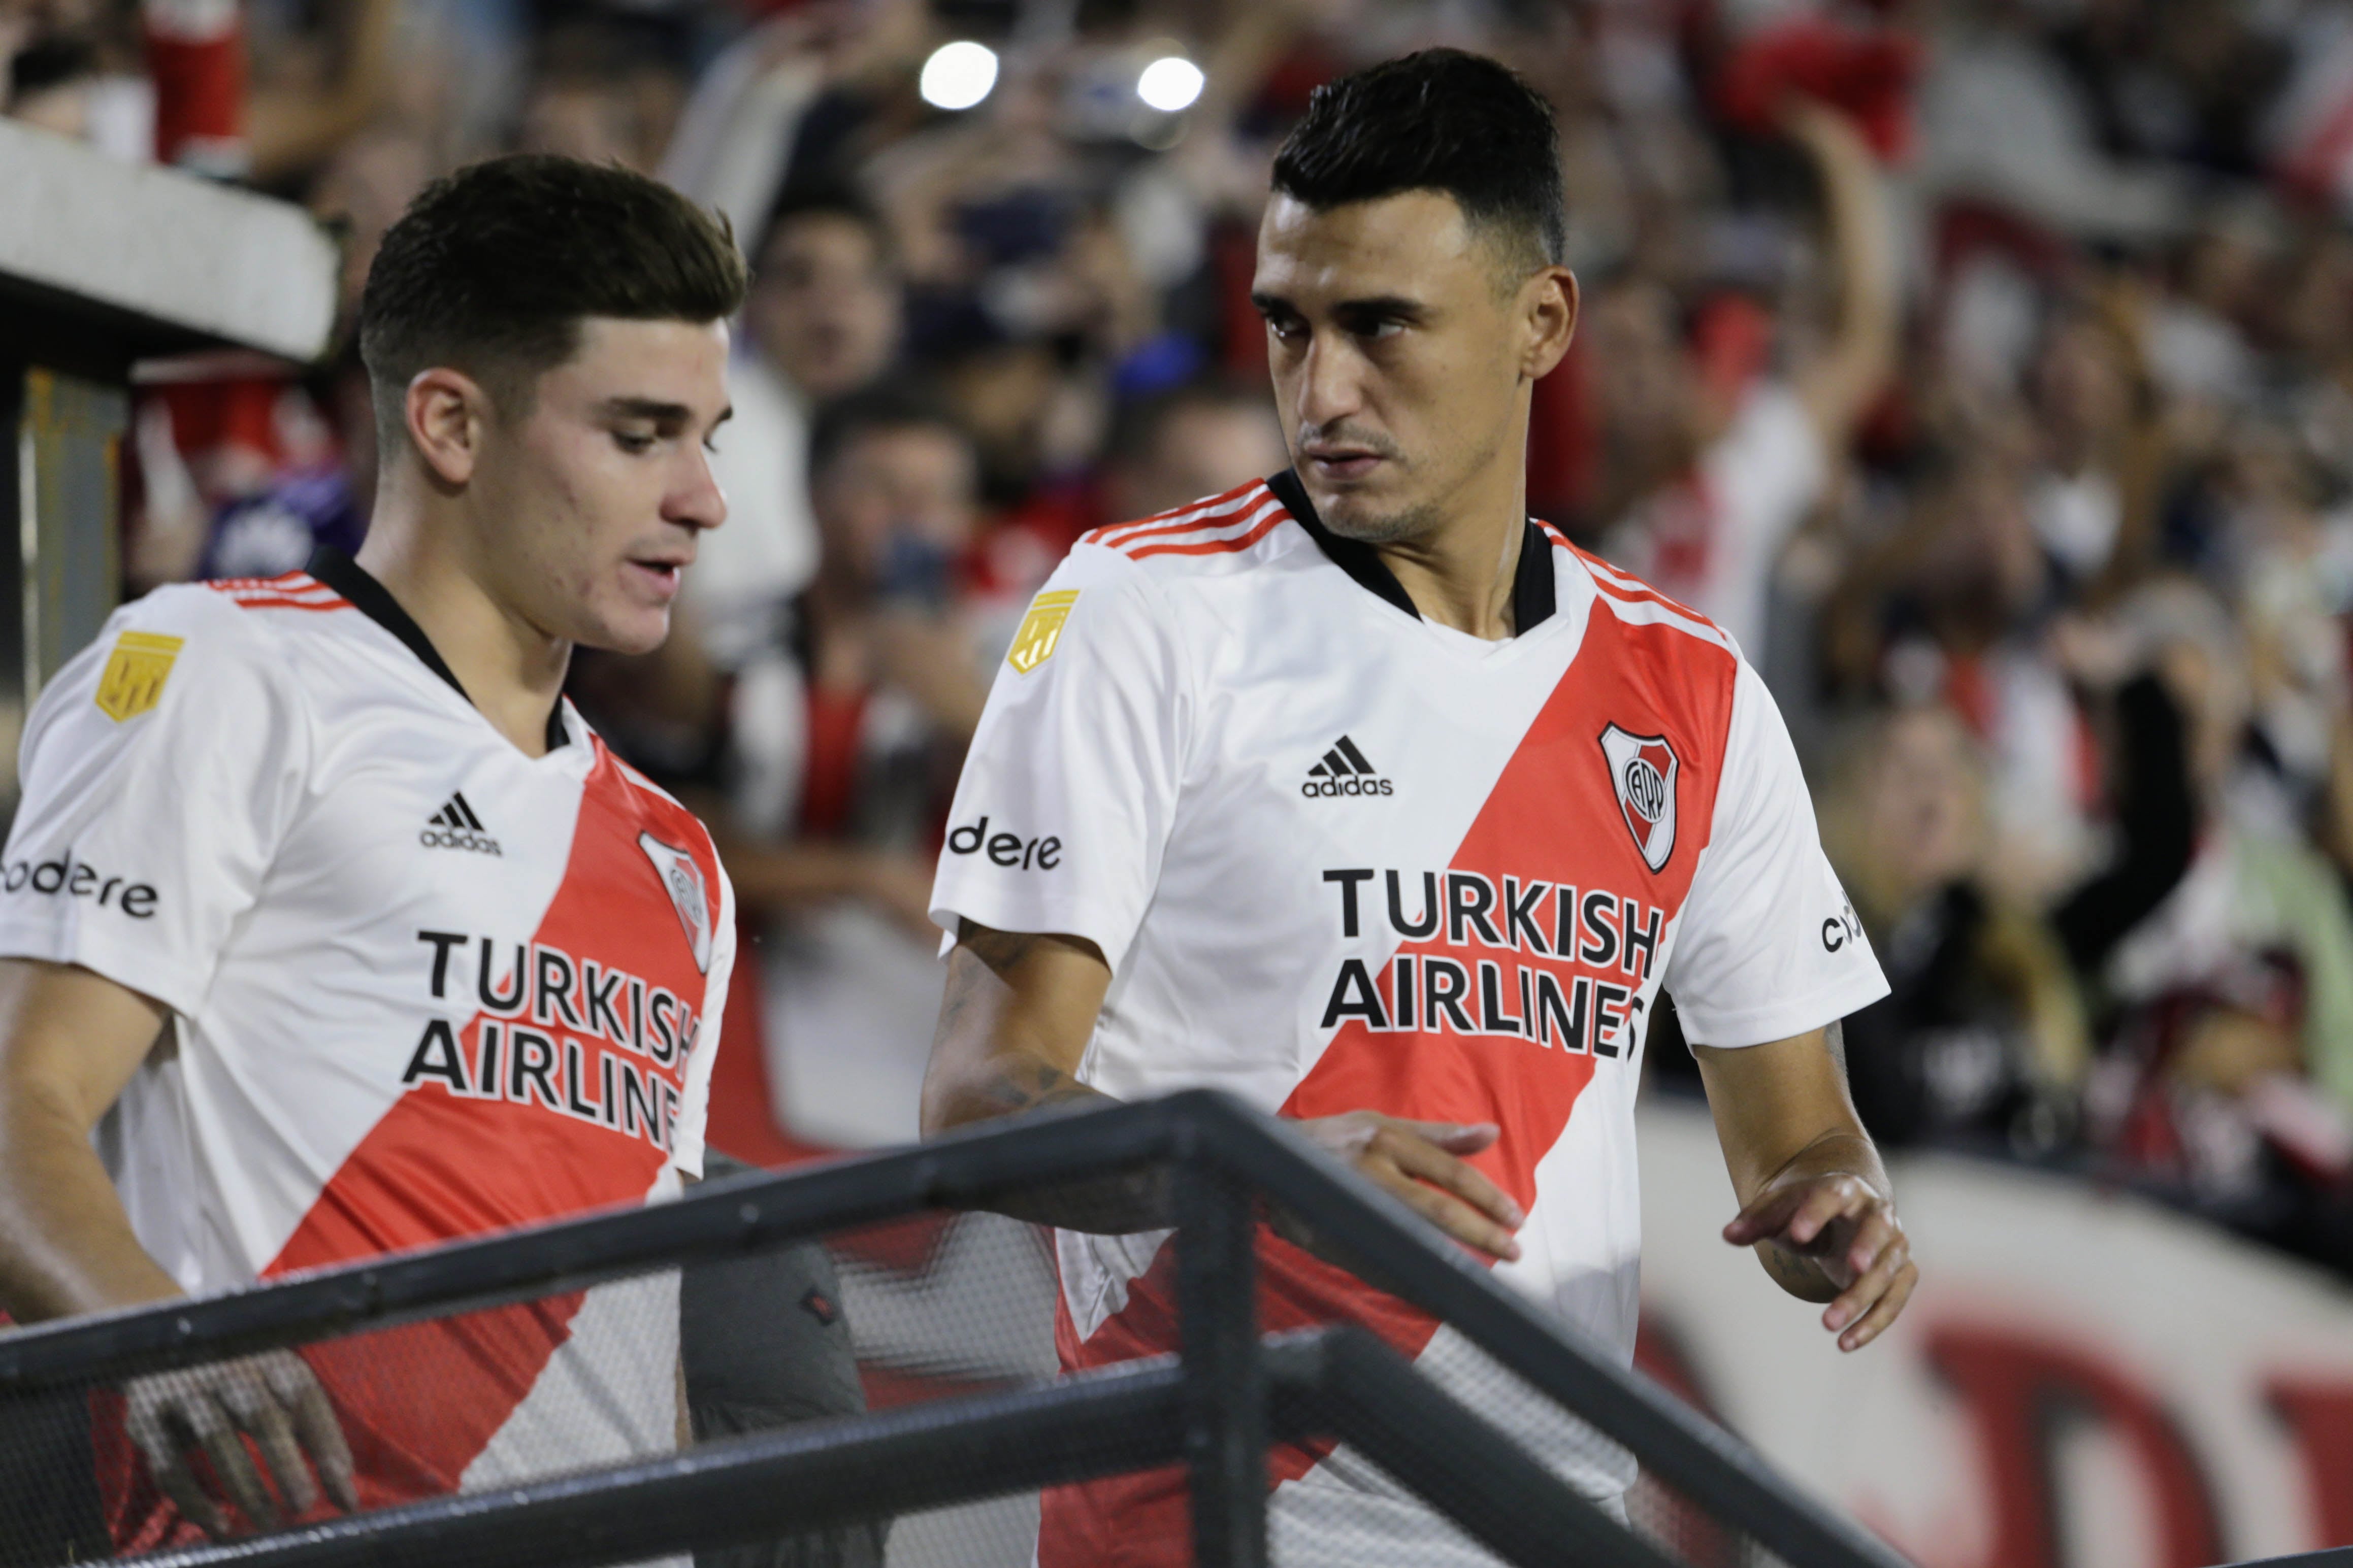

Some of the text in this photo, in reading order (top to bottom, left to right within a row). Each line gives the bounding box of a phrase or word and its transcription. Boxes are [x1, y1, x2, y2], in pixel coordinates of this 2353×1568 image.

[1302, 775, 1393, 797] adidas
[419, 828, 502, 856] adidas
[0, 848, 158, 917] odere
[1323, 869, 1661, 980] TURKISH
[418, 930, 700, 1075] TURKISH
